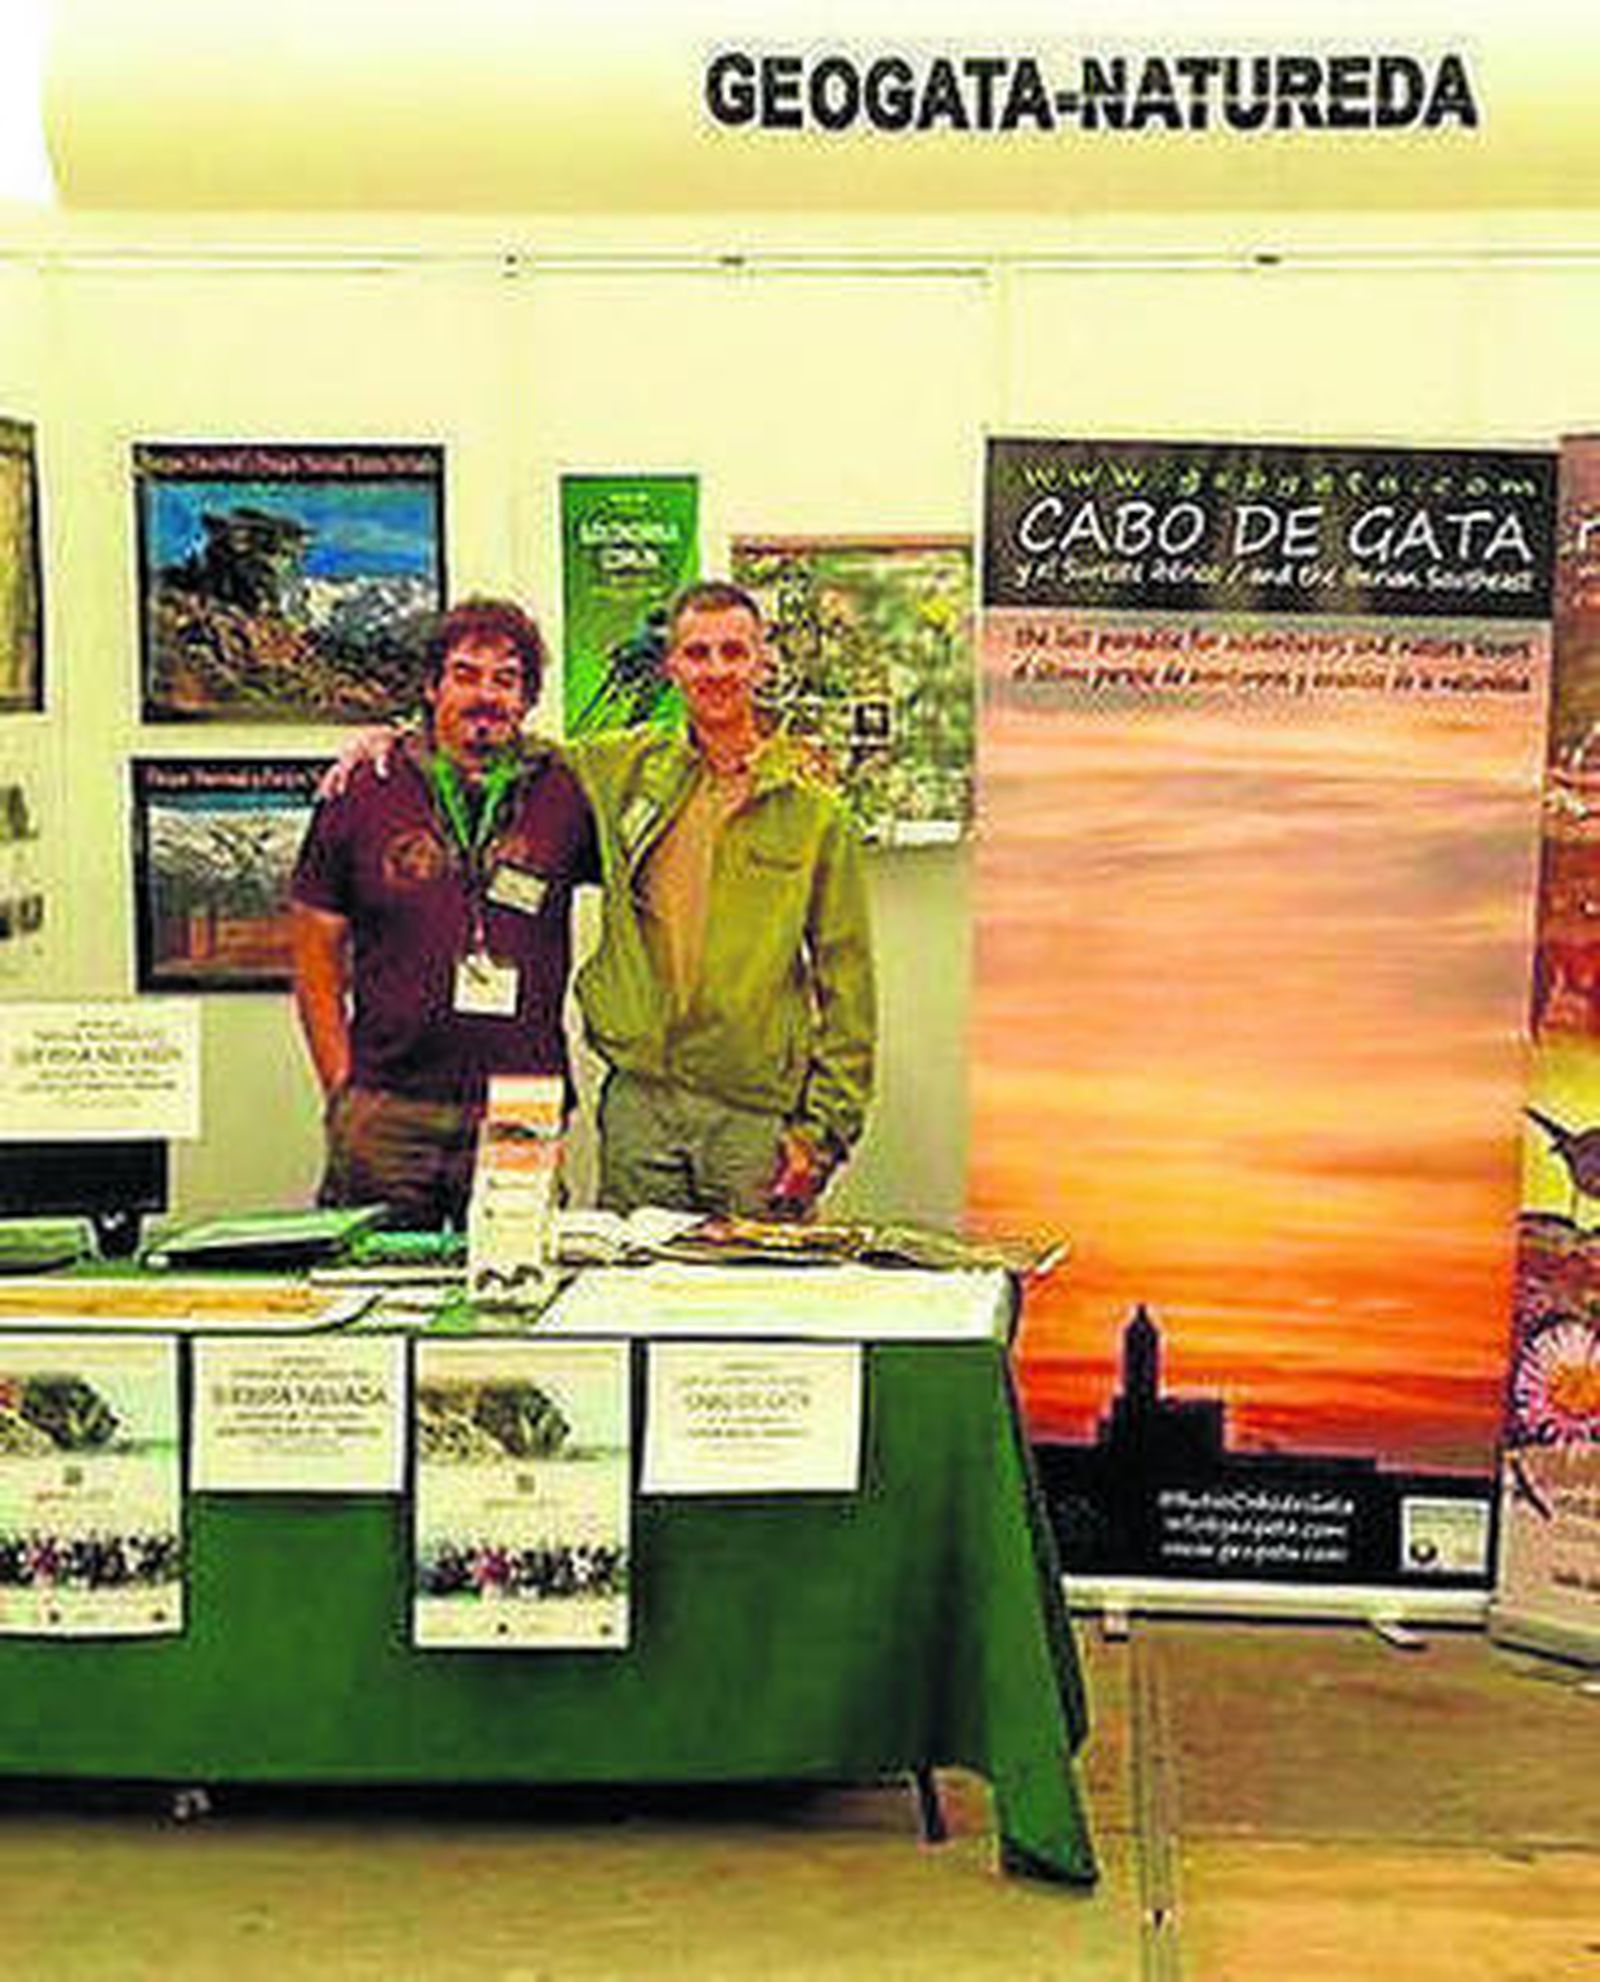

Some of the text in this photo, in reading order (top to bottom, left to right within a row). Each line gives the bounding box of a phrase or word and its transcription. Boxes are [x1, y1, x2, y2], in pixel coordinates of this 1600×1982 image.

[705, 52, 1478, 132] GEOGATA-NATUREDA
[1018, 498, 1206, 555] CABO
[1233, 504, 1324, 558] DE
[1348, 505, 1534, 563] GATA
